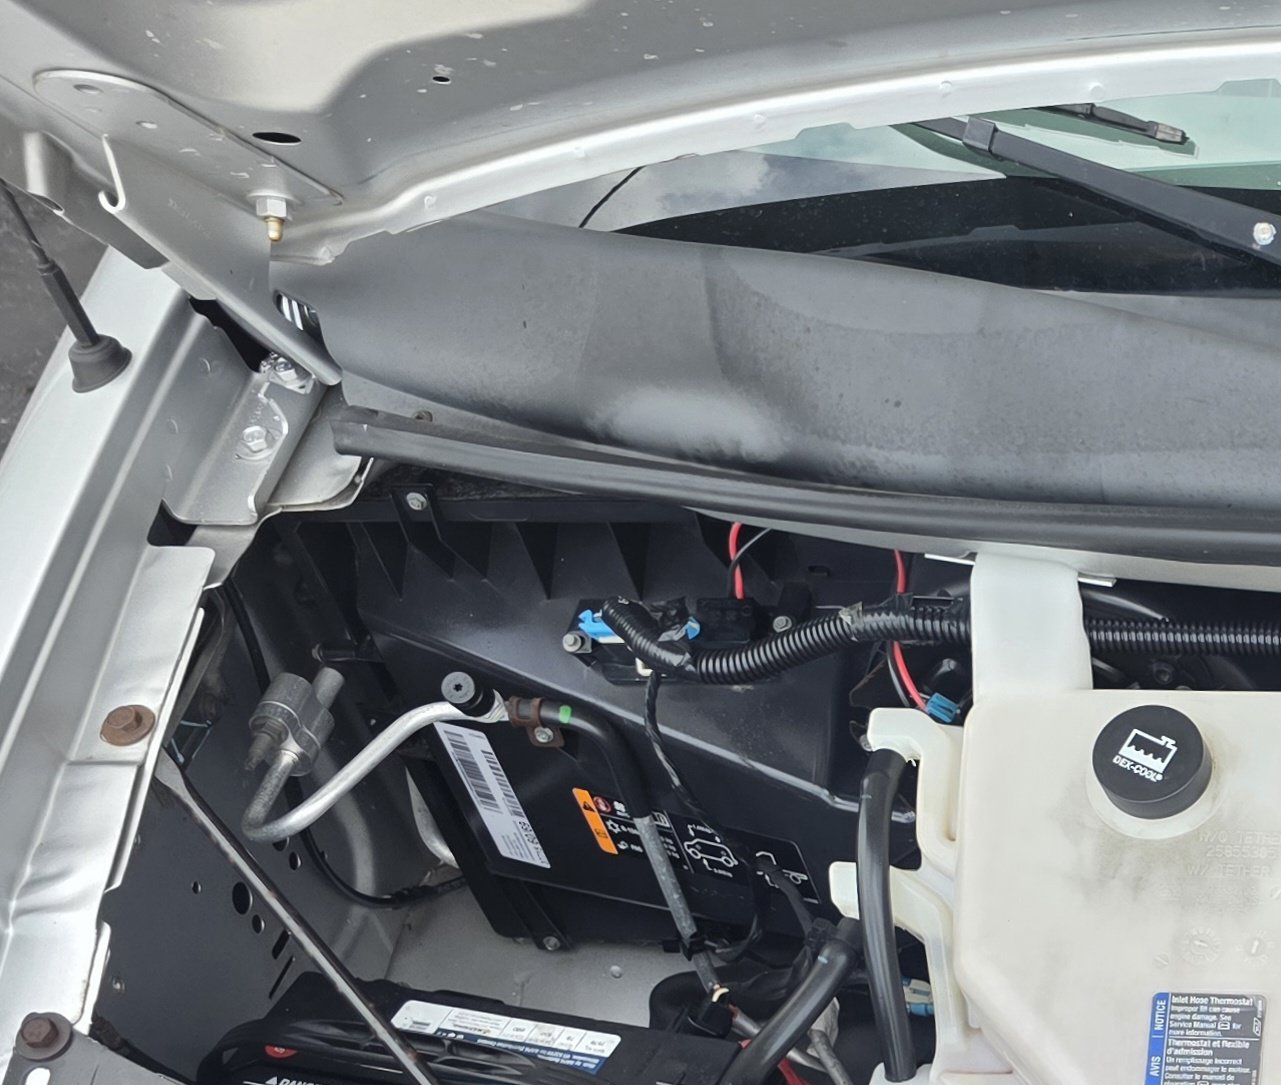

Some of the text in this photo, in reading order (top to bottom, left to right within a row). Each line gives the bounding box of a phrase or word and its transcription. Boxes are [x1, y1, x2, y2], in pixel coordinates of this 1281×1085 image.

[1172, 996, 1253, 1006] Inlet Hose Thermostat
[1154, 1000, 1166, 1031] NOTICE
[1149, 1056, 1161, 1077] AVIS
